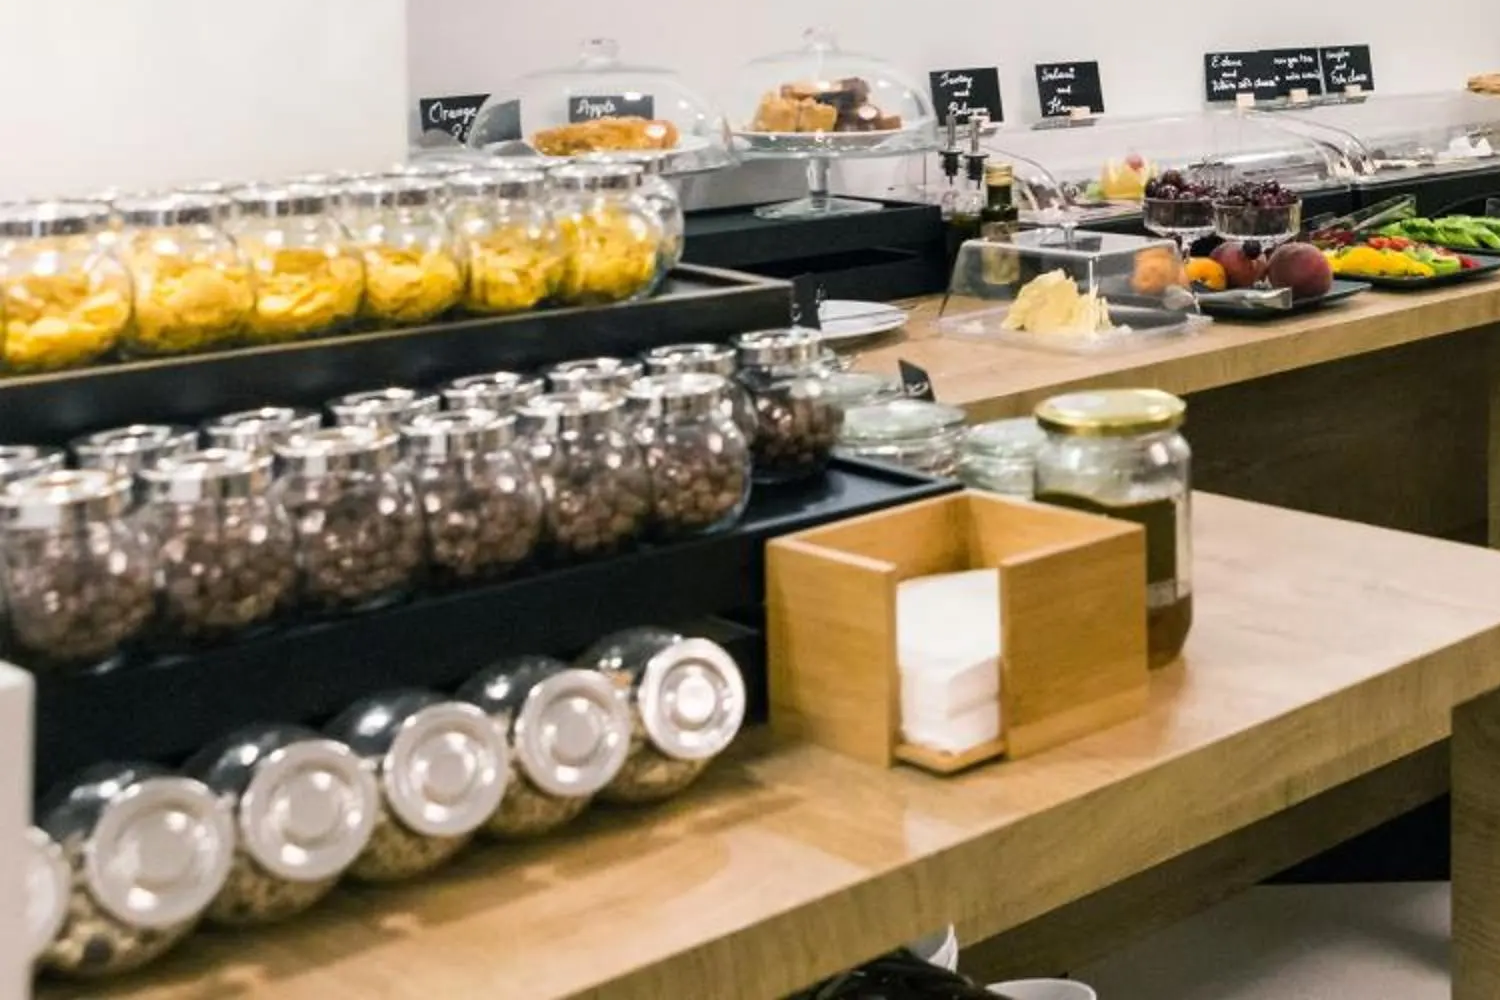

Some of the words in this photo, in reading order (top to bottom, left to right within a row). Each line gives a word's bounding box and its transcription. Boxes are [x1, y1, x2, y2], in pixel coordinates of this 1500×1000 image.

[1042, 67, 1075, 81] Salami
[1221, 68, 1237, 78] and
[1056, 85, 1072, 95] and
[429, 101, 477, 125] Orange
[576, 98, 616, 118] Apple
